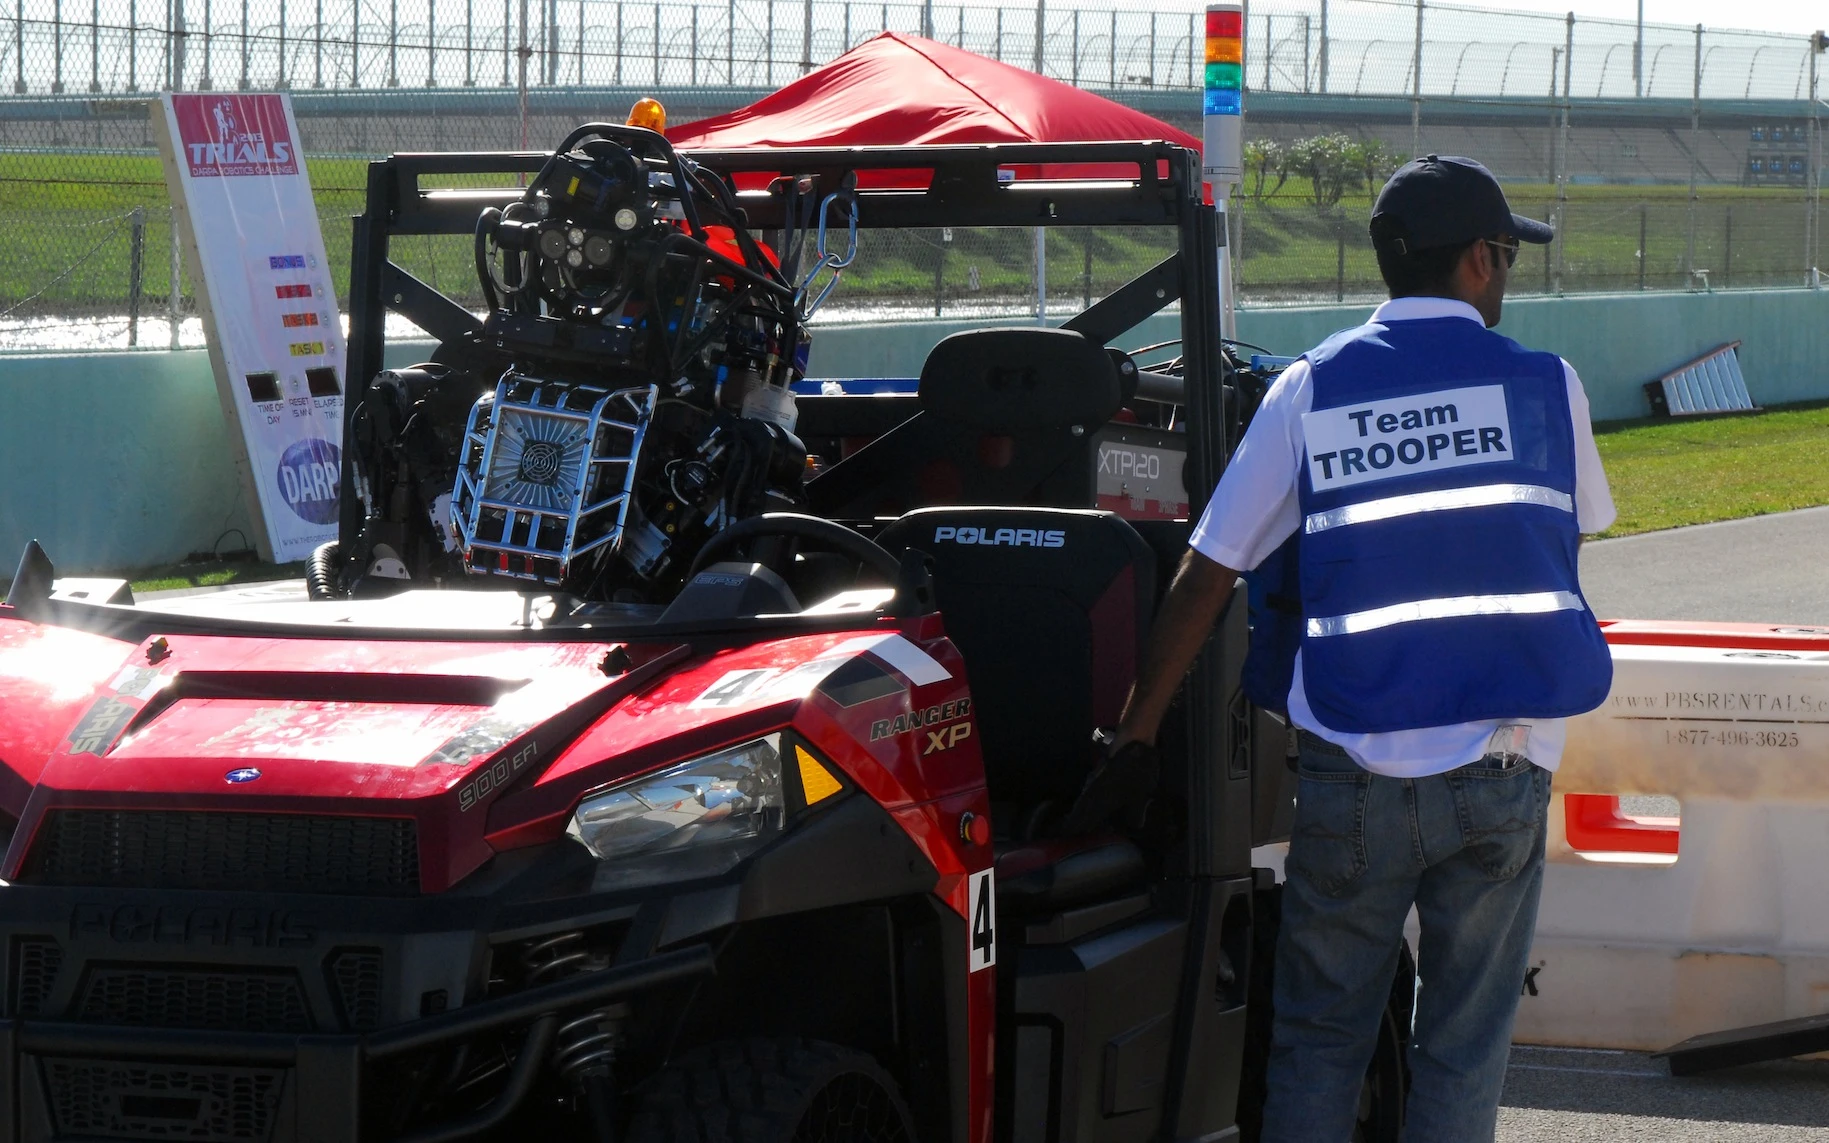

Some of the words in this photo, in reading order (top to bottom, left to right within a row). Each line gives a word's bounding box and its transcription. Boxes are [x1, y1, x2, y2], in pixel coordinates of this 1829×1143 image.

[188, 142, 289, 165] TRIALS
[192, 167, 219, 176] DARPA
[290, 343, 316, 355] TASK
[267, 415, 280, 425] DAY
[1348, 403, 1459, 437] Team
[1313, 426, 1507, 480] TROOPER
[282, 460, 341, 504] DARP
[934, 527, 1066, 548] POLARIS
[703, 671, 769, 706] 4
[870, 697, 972, 742] RANGER
[923, 721, 972, 756] XP
[1665, 730, 1799, 748] 1-877-496-3625
[459, 757, 510, 812] 900
[513, 740, 538, 770] EFI
[972, 874, 994, 964] 4
